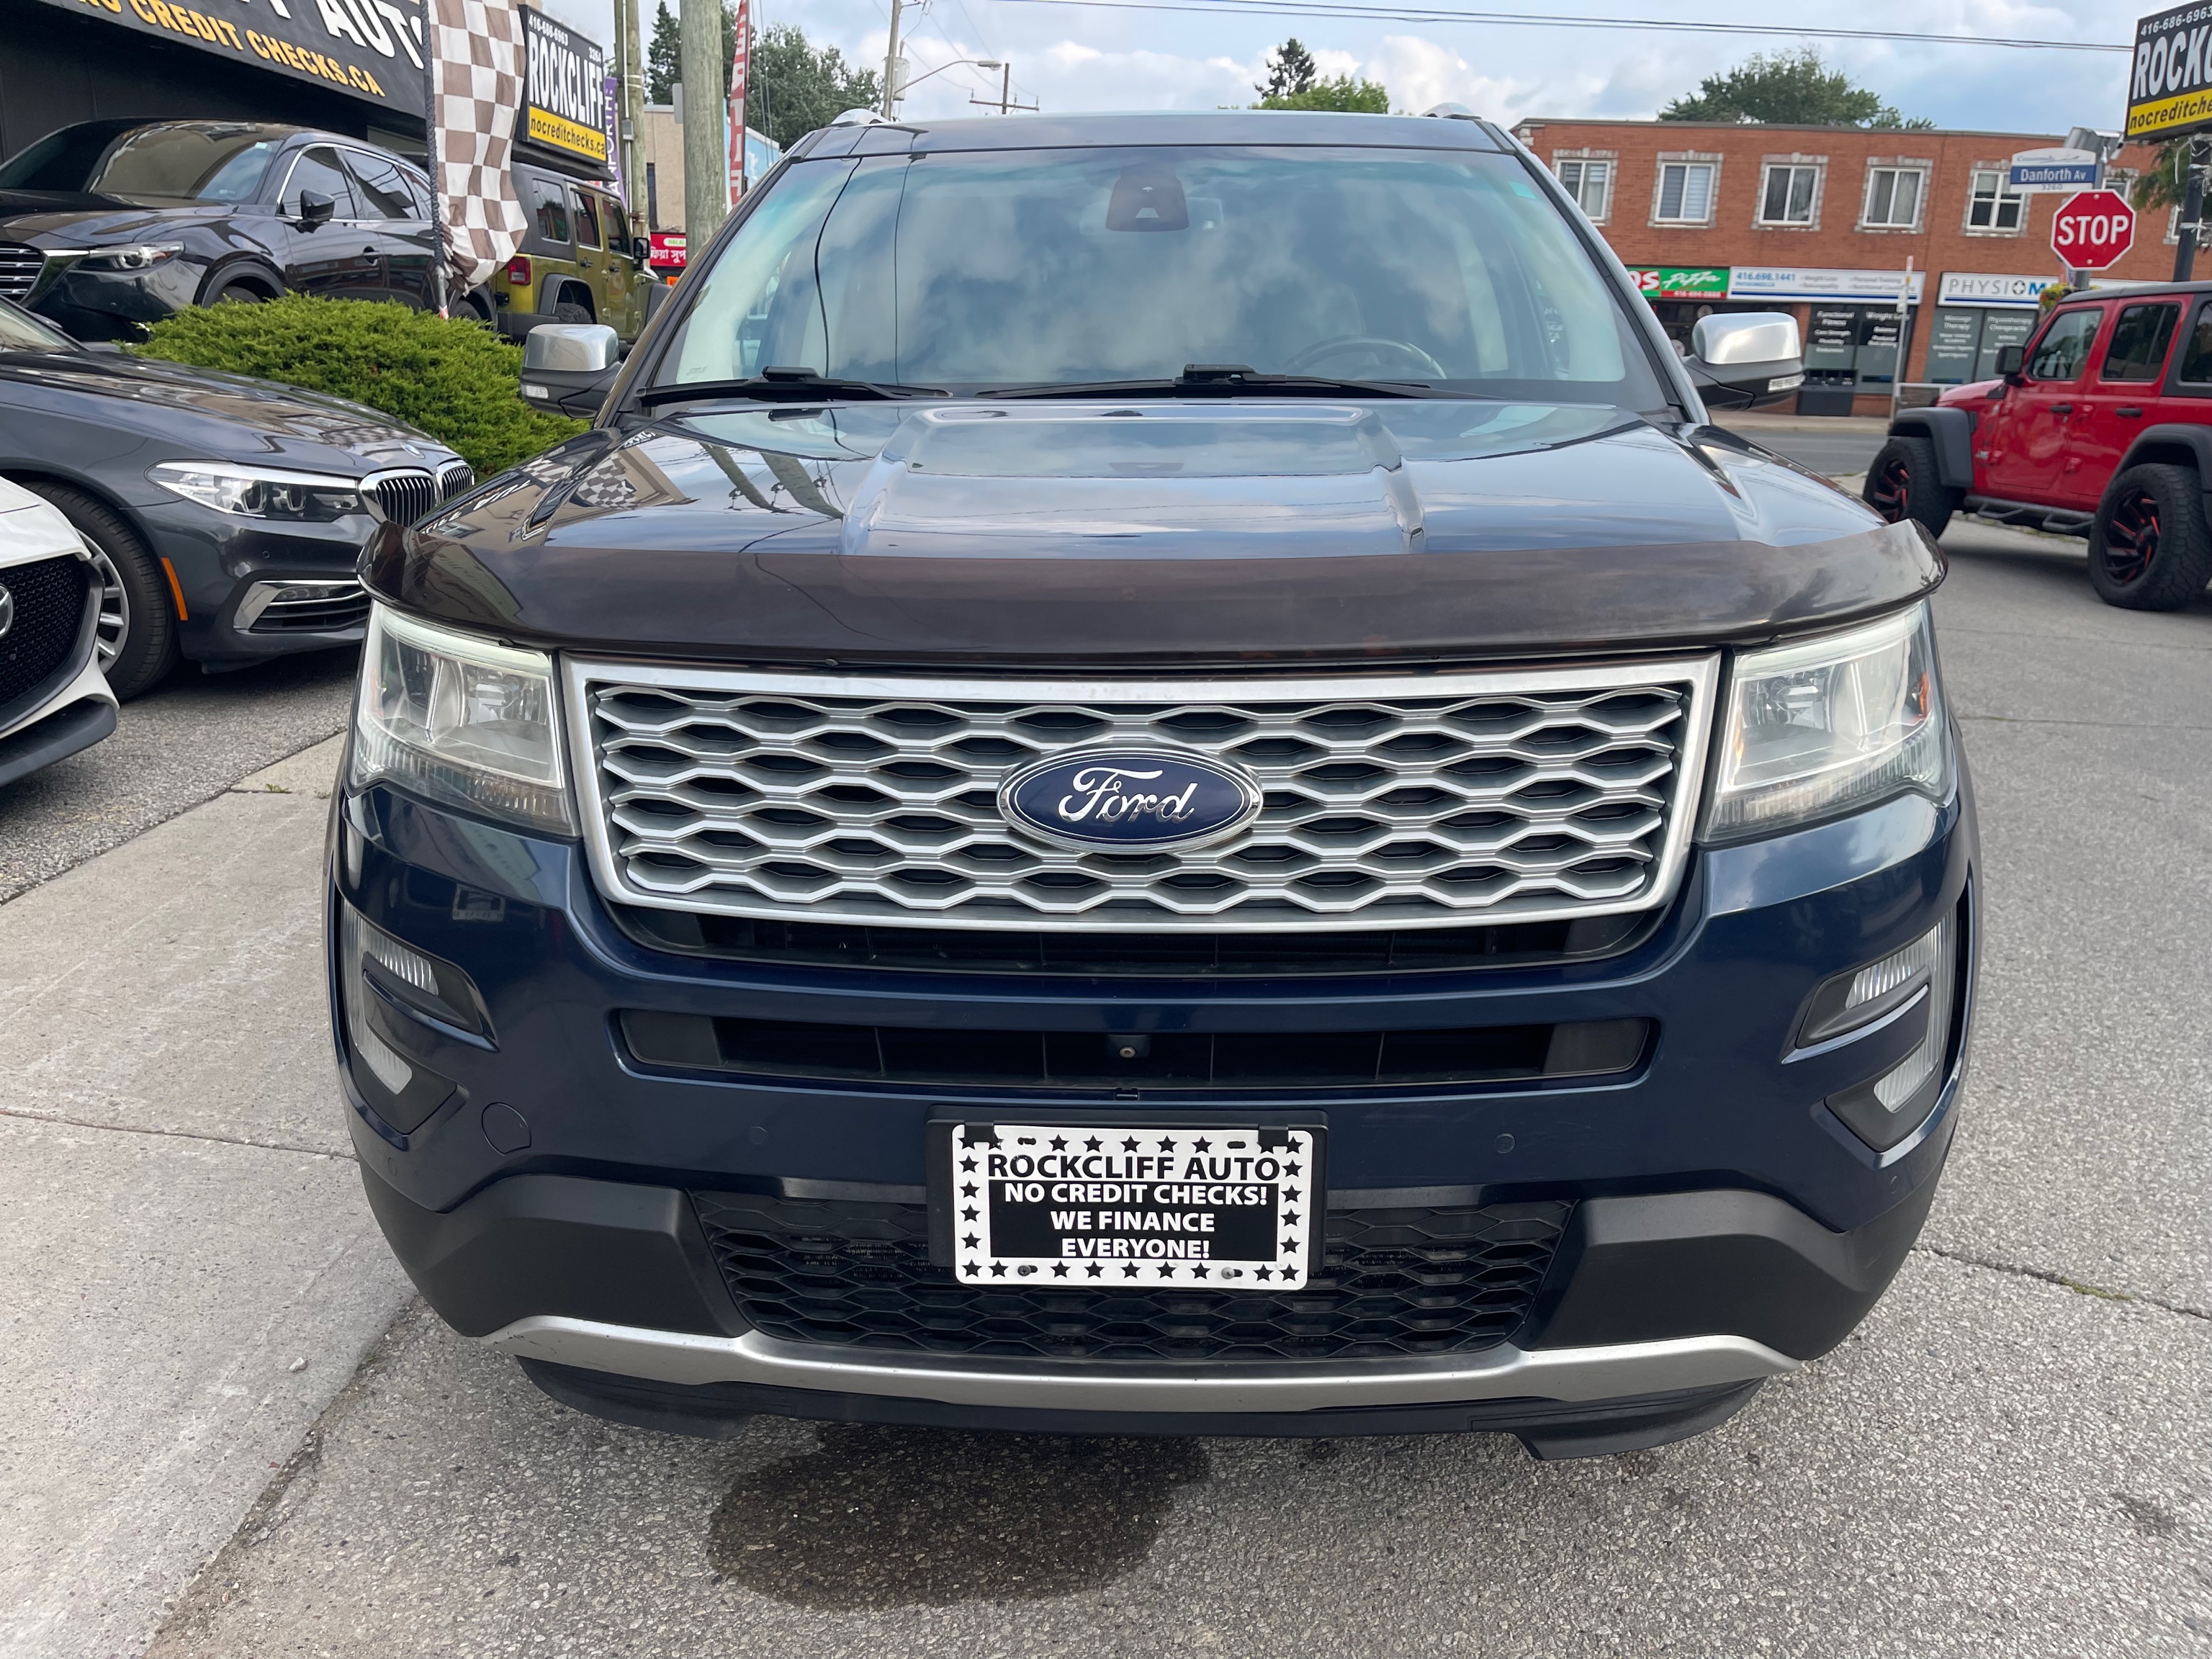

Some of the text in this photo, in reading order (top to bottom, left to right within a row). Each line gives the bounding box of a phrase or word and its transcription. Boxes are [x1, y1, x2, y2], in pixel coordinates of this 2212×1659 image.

[315, 0, 423, 69] AUT
[2141, 5, 2212, 36] 416-686-6963
[128, 0, 386, 97] CREDIT CHECKS.CA
[2132, 24, 2212, 100] ROCK
[529, 32, 604, 130] ROCKCLIFF
[531, 117, 605, 155] nocreditchecks.ca
[2020, 168, 2087, 181] Danforth Av
[2057, 215, 2129, 246] STOP
[1948, 278, 2046, 295] PHYSIOM
[1058, 767, 1198, 822] Ford
[988, 1154, 1280, 1181] ROCKCLIFF AUTO
[1005, 1182, 1267, 1205] NO CREDIT CHECKS!
[1051, 1210, 1215, 1233] WE FINANCE
[1061, 1238, 1210, 1259] EVERYONE!
